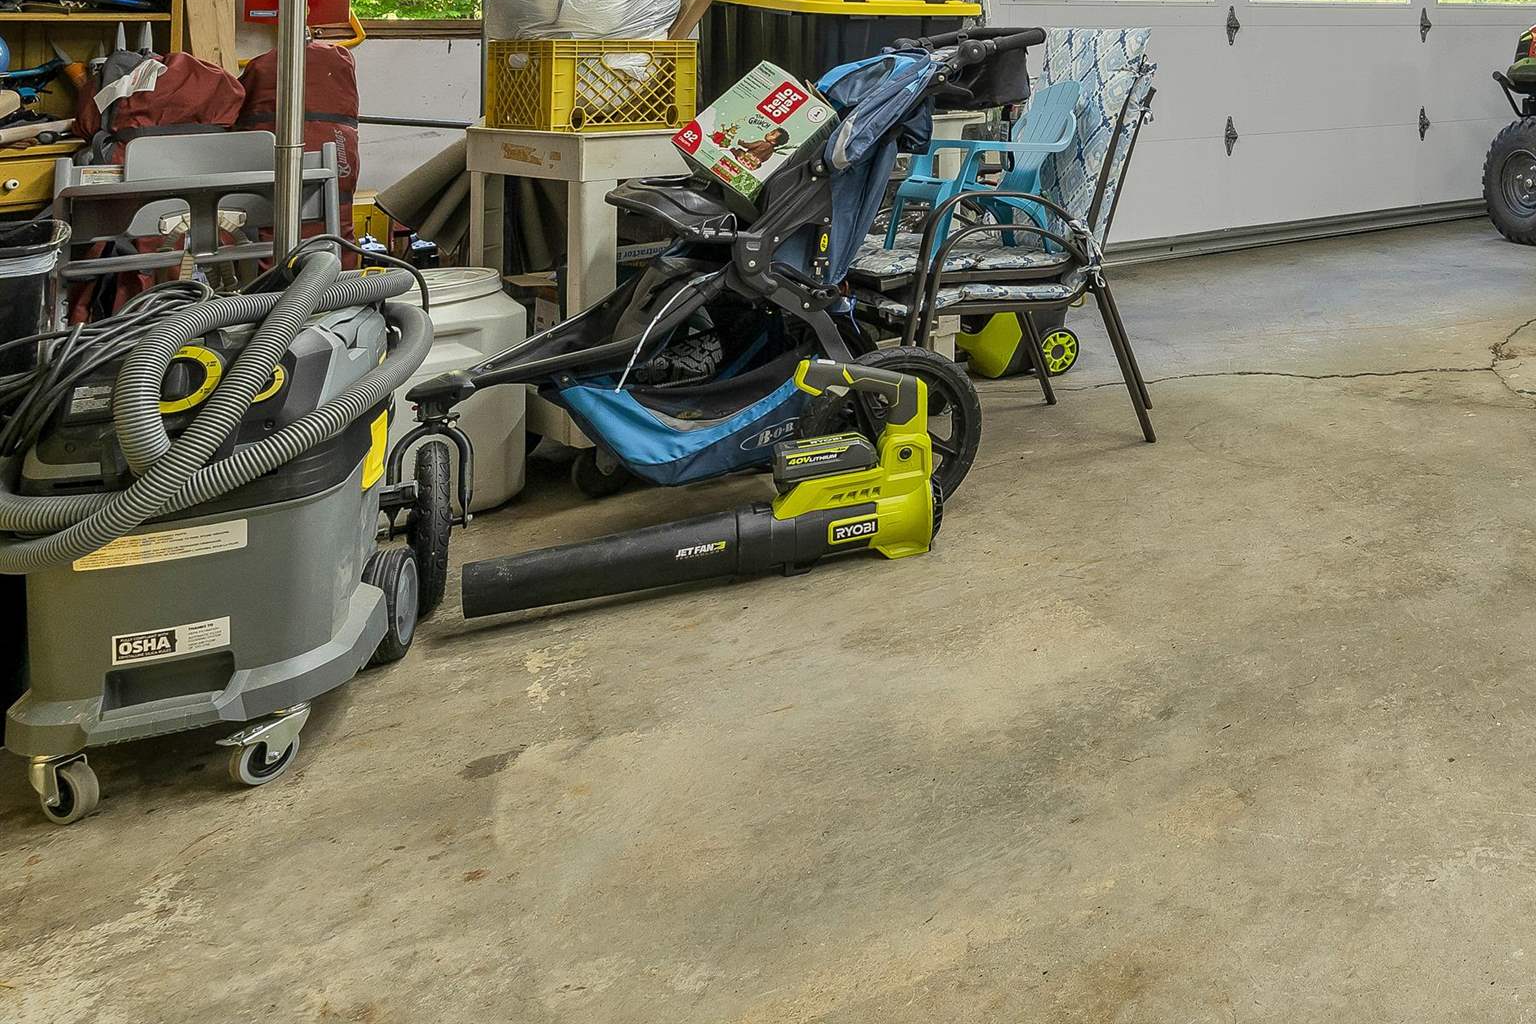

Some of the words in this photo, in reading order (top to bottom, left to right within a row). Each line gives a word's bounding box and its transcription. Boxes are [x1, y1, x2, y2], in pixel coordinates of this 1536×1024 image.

[763, 88, 793, 113] hello
[683, 130, 698, 143] 82
[788, 456, 810, 466] 40V
[836, 521, 877, 539] RYOBI
[675, 547, 694, 558] JET
[694, 543, 715, 554] FAN
[118, 637, 171, 655] OSHA
